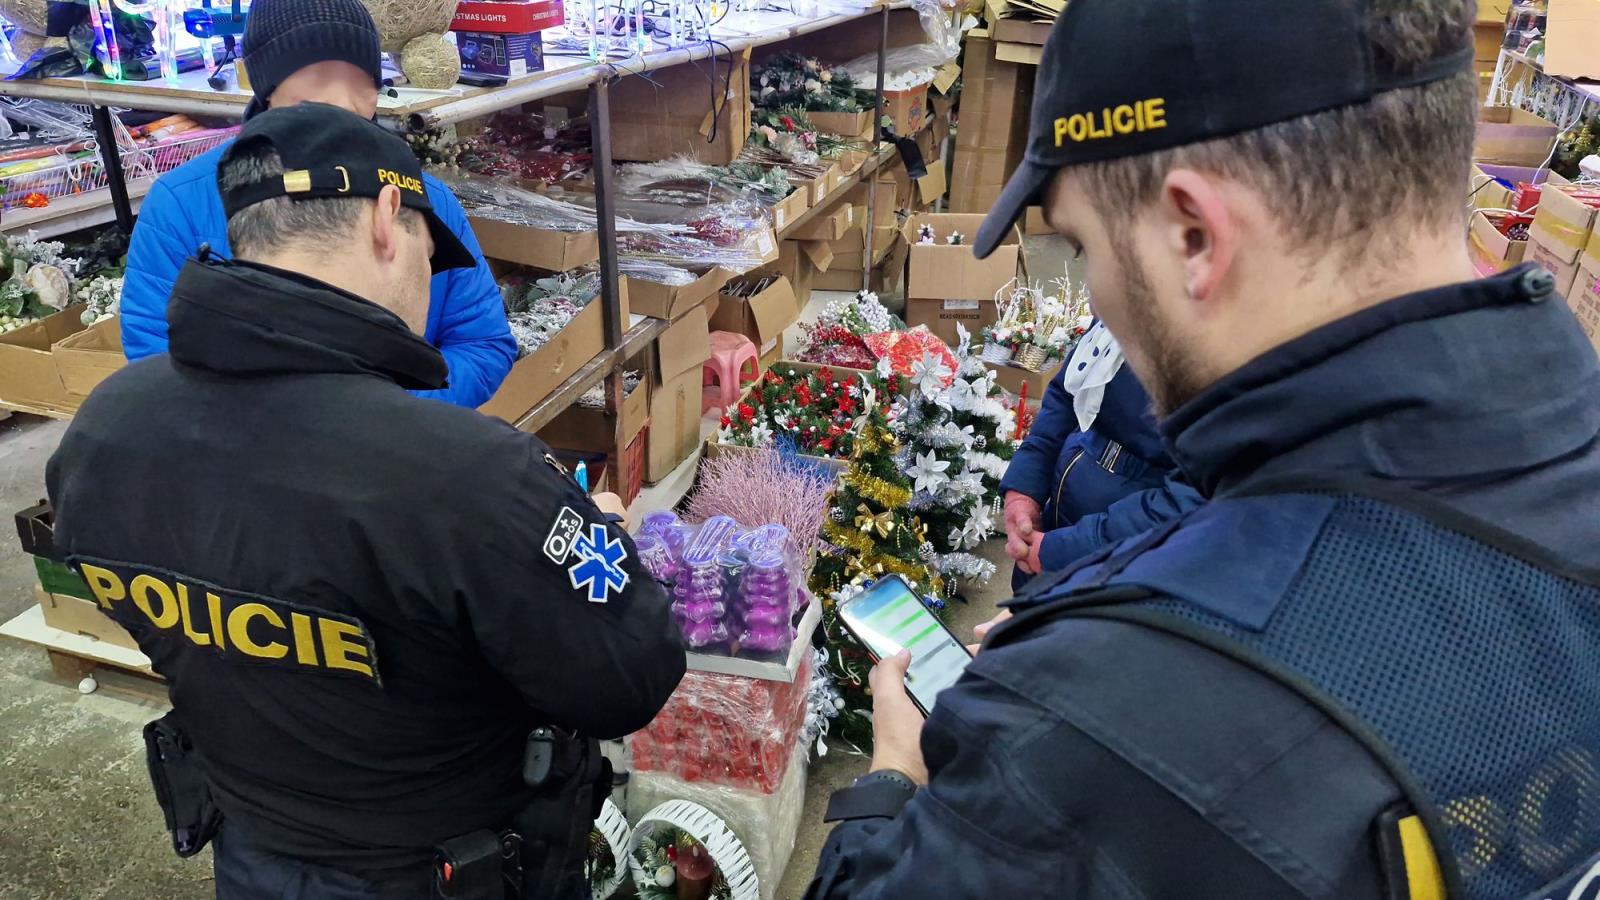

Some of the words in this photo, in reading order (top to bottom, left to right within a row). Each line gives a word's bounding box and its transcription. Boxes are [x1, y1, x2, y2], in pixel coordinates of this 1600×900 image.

[480, 14, 507, 22] LIGHTS
[1054, 98, 1167, 146] POLICIE
[378, 169, 423, 194] POLICIE
[564, 519, 578, 539] POS
[80, 562, 373, 677] POLICIE
